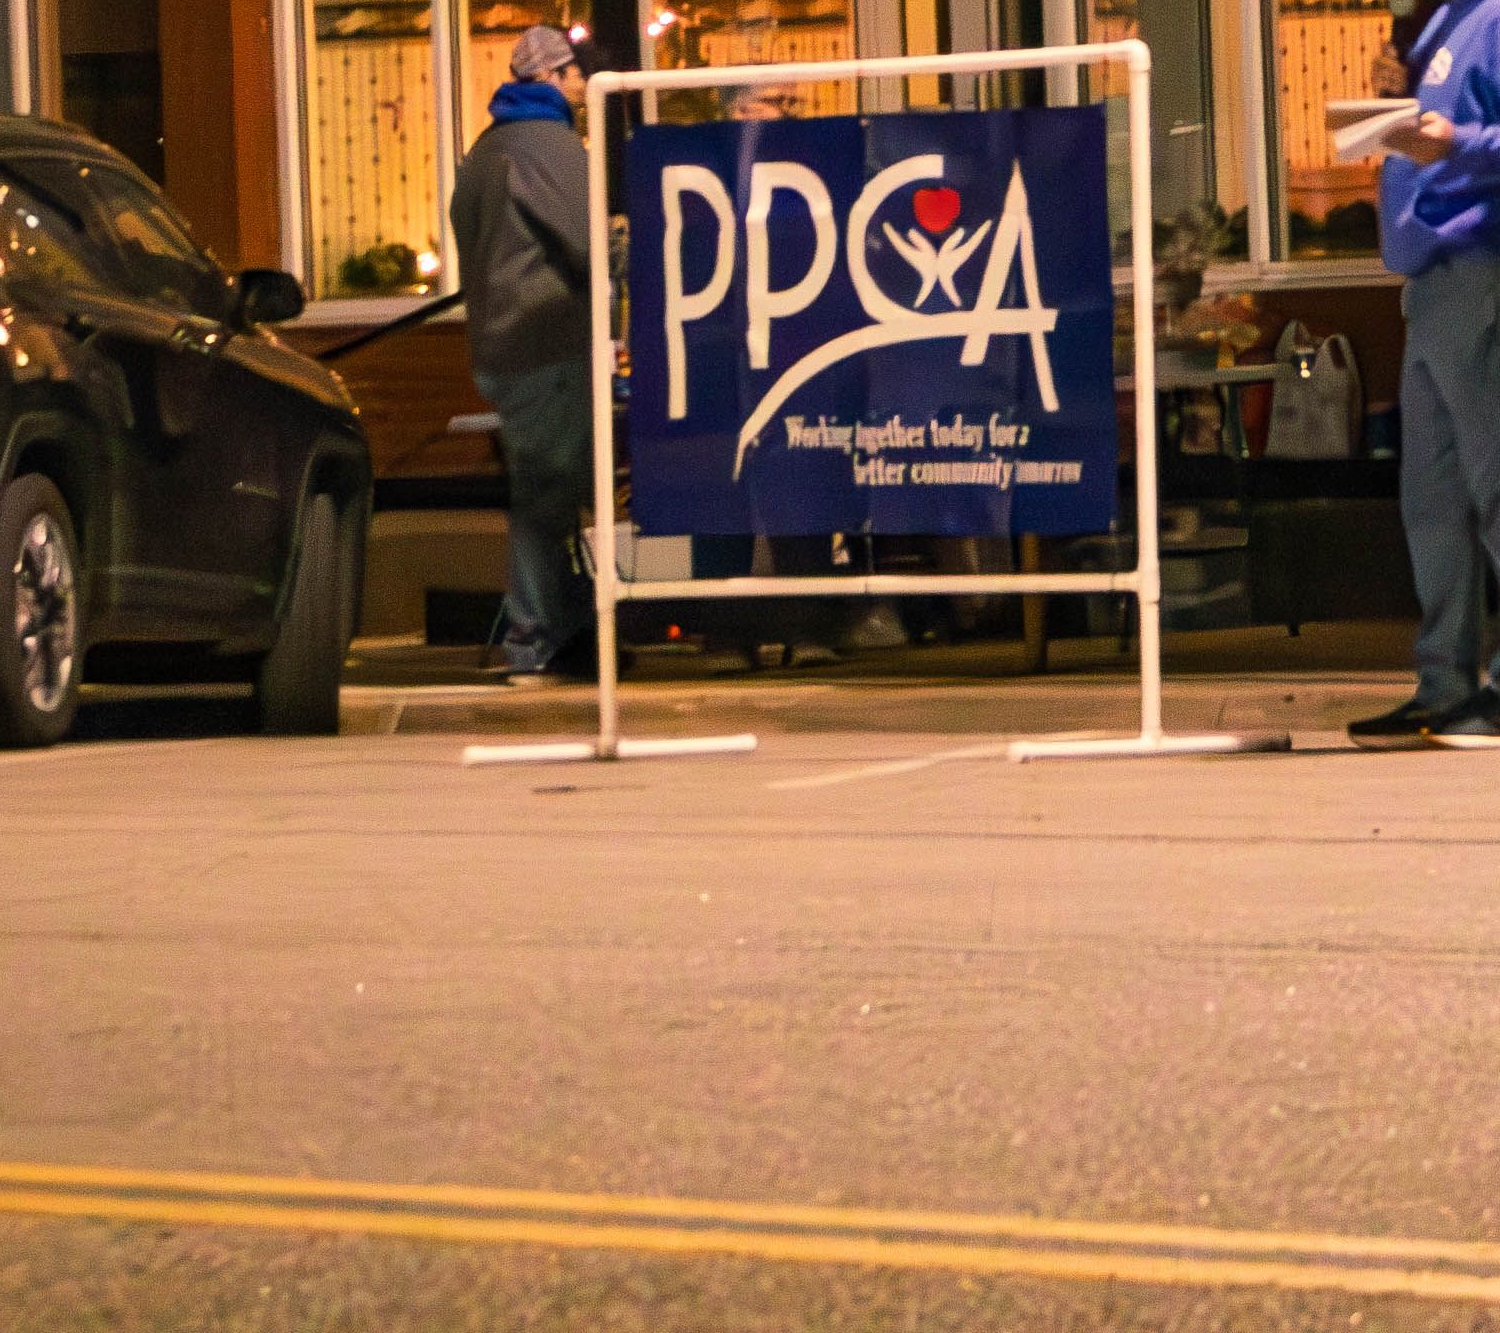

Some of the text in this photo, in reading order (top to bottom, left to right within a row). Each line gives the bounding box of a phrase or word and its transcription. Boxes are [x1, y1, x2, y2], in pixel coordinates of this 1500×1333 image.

[661, 154, 1060, 422] PPCA
[785, 414, 853, 454] Working
[930, 413, 984, 452] today
[989, 412, 1018, 447] for
[911, 452, 1014, 490] community
[1015, 459, 1083, 485] omorrow
